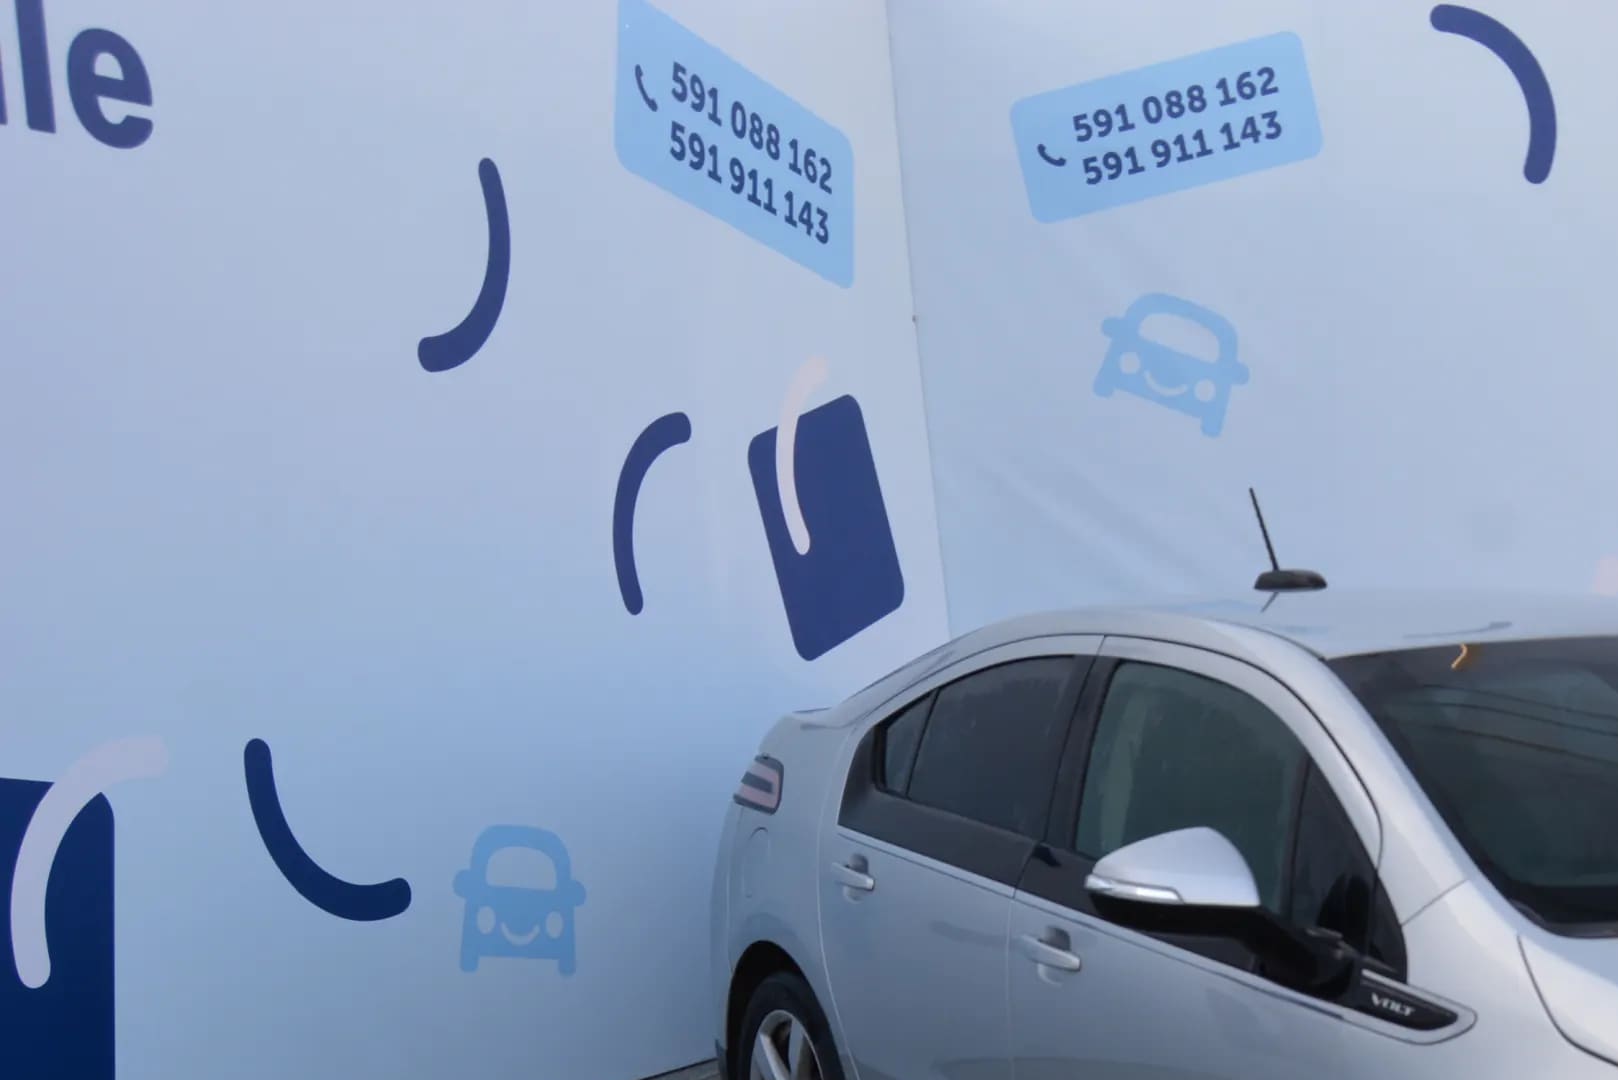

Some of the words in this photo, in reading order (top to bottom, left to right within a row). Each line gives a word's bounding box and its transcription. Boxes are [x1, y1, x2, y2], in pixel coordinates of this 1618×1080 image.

[0, 0, 154, 150] le
[1072, 103, 1136, 143] 591
[1142, 84, 1208, 125] 088
[1215, 66, 1279, 107] 162
[671, 62, 723, 127] 591
[730, 100, 781, 161] 088
[788, 138, 833, 195] 162
[1082, 145, 1146, 185] 591
[1150, 128, 1214, 169] 911
[1219, 110, 1282, 152] 143
[669, 120, 723, 185] 591
[729, 157, 778, 217] 911
[783, 190, 830, 245] 143
[1371, 992, 1414, 1017] VOLT
